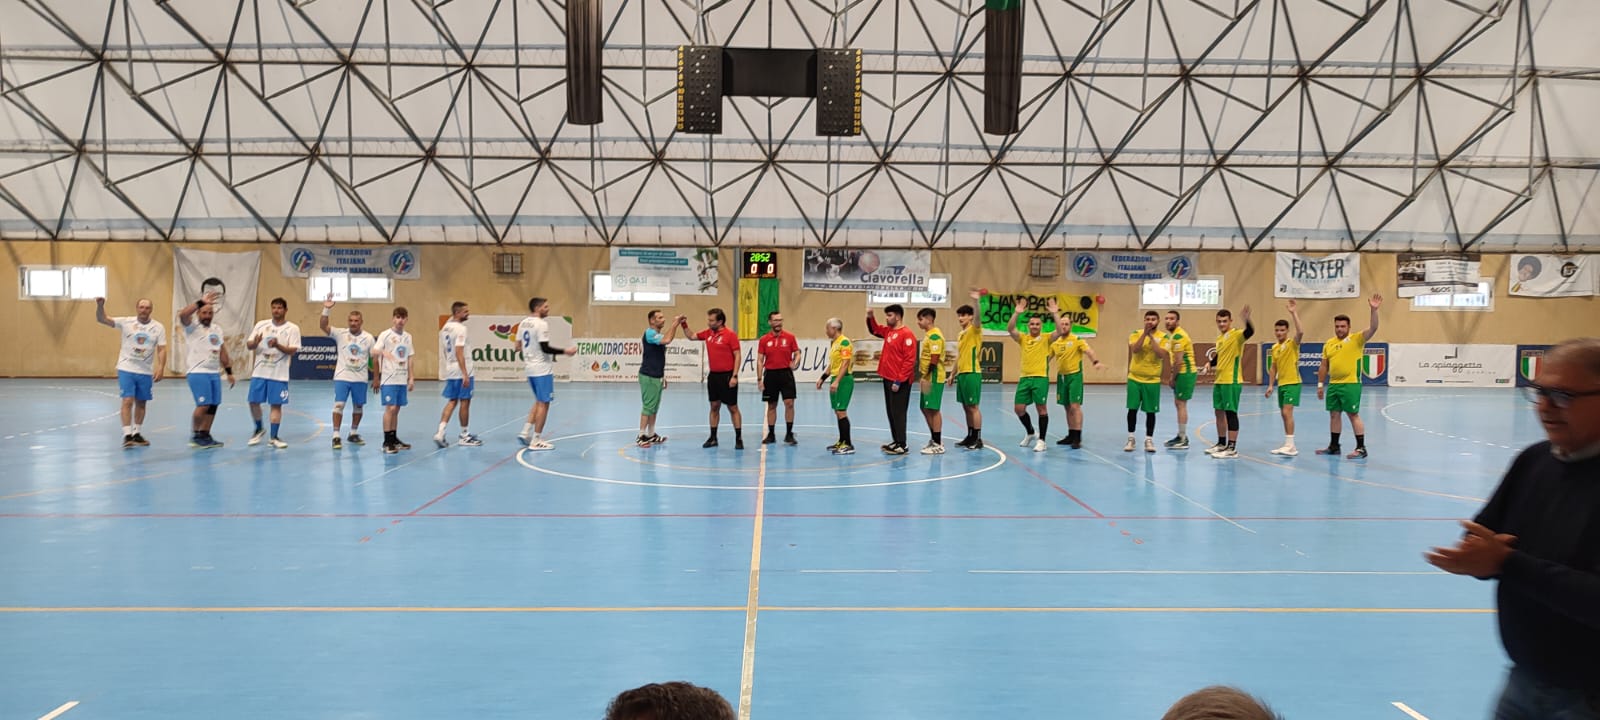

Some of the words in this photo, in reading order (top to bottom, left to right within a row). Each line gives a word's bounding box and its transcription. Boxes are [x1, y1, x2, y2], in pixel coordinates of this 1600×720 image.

[751, 264, 758, 274] 0
[767, 264, 774, 274] 0
[1291, 258, 1345, 279] FASTER
[860, 272, 924, 285] Ciavorella
[523, 330, 531, 348] 9
[577, 342, 642, 356] TERMOIDROSERV
[1430, 362, 1483, 374] spiaggetta
